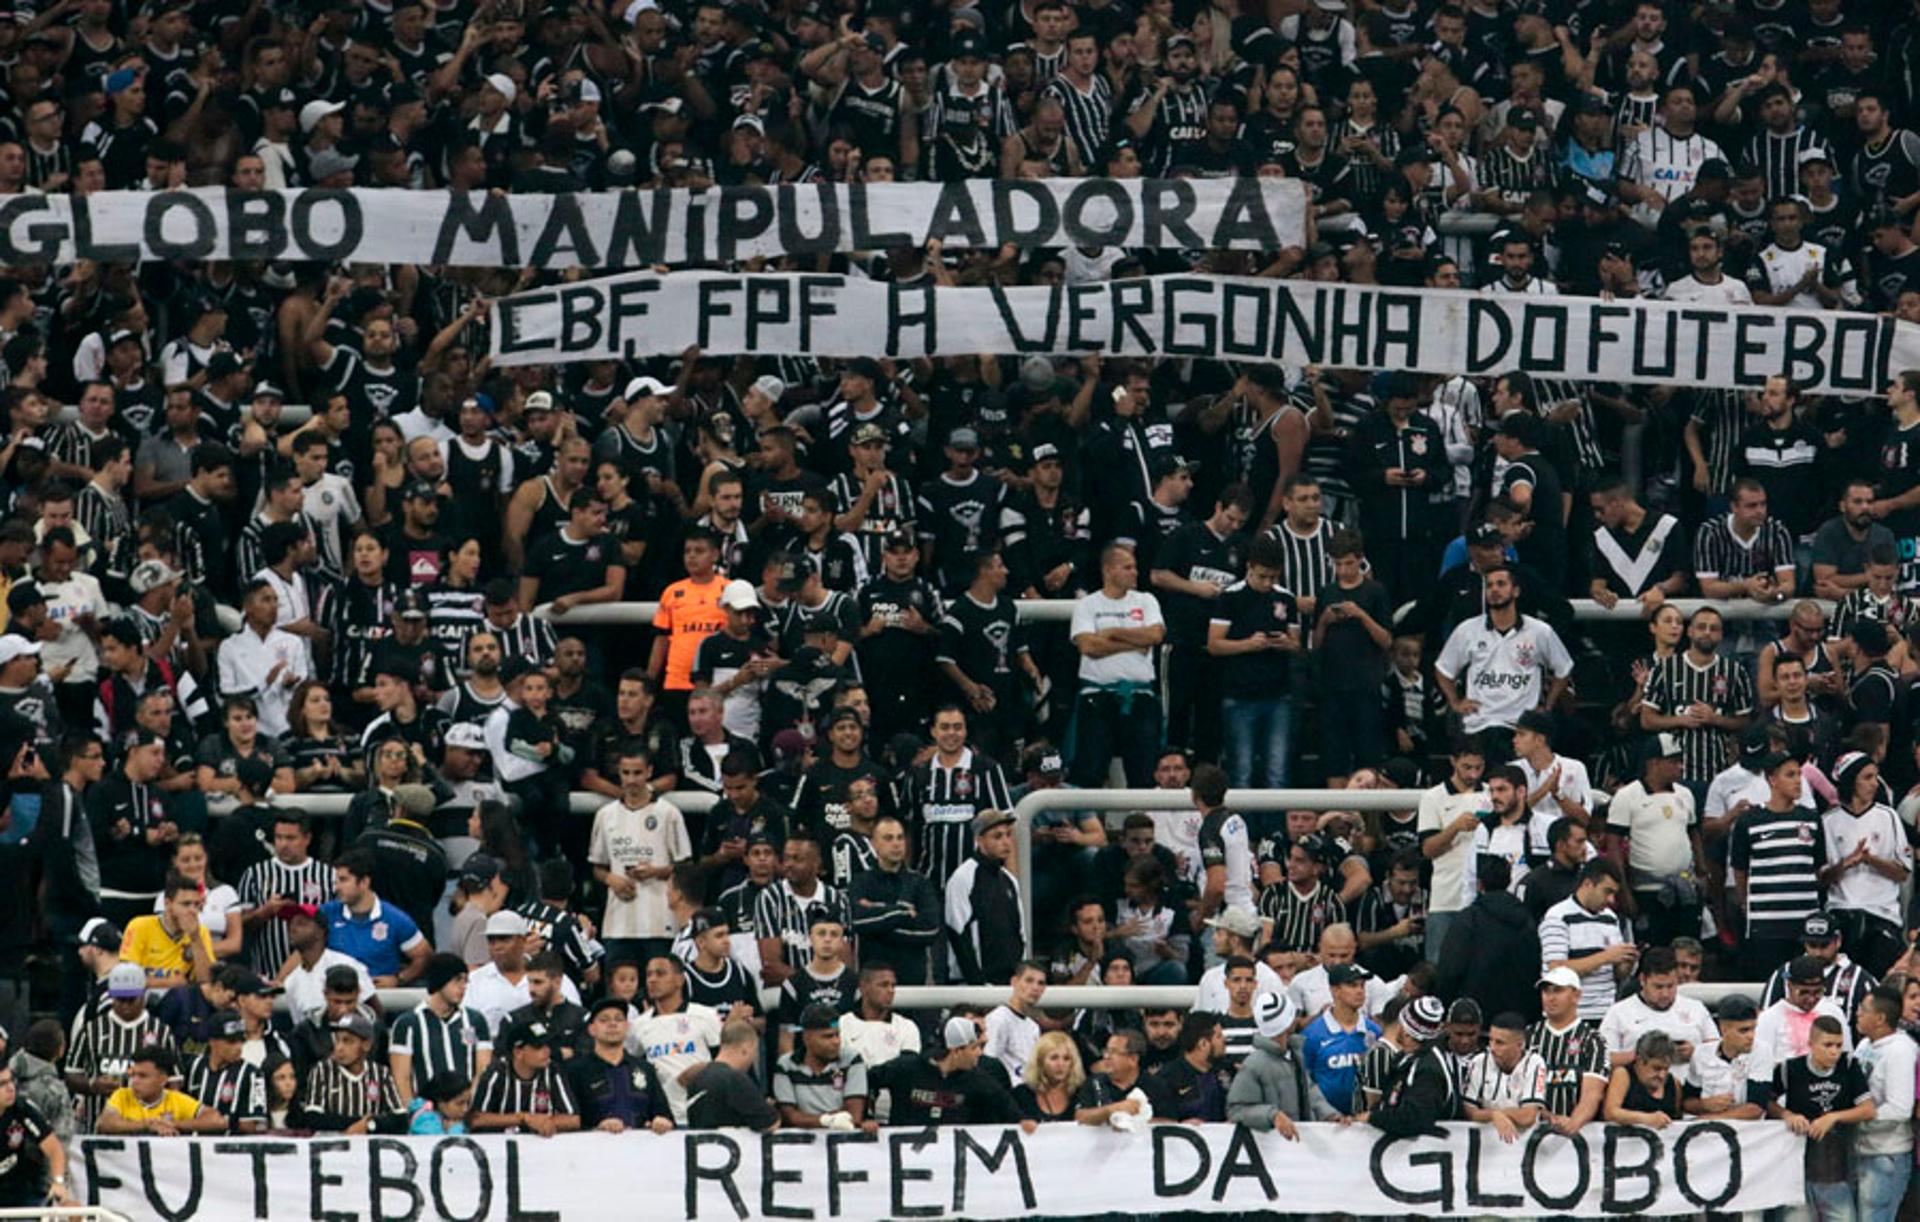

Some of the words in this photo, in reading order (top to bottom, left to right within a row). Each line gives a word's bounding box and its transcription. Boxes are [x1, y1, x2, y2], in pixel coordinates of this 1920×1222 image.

[0, 186, 364, 267] GLOBO
[698, 277, 845, 353] FPF
[988, 279, 1421, 368] VERGONHA
[1467, 298, 1568, 372] DO
[81, 1137, 559, 1222] FUTEBOL
[1152, 1125, 1279, 1201] DA
[1369, 1121, 1742, 1212] GLOBO
